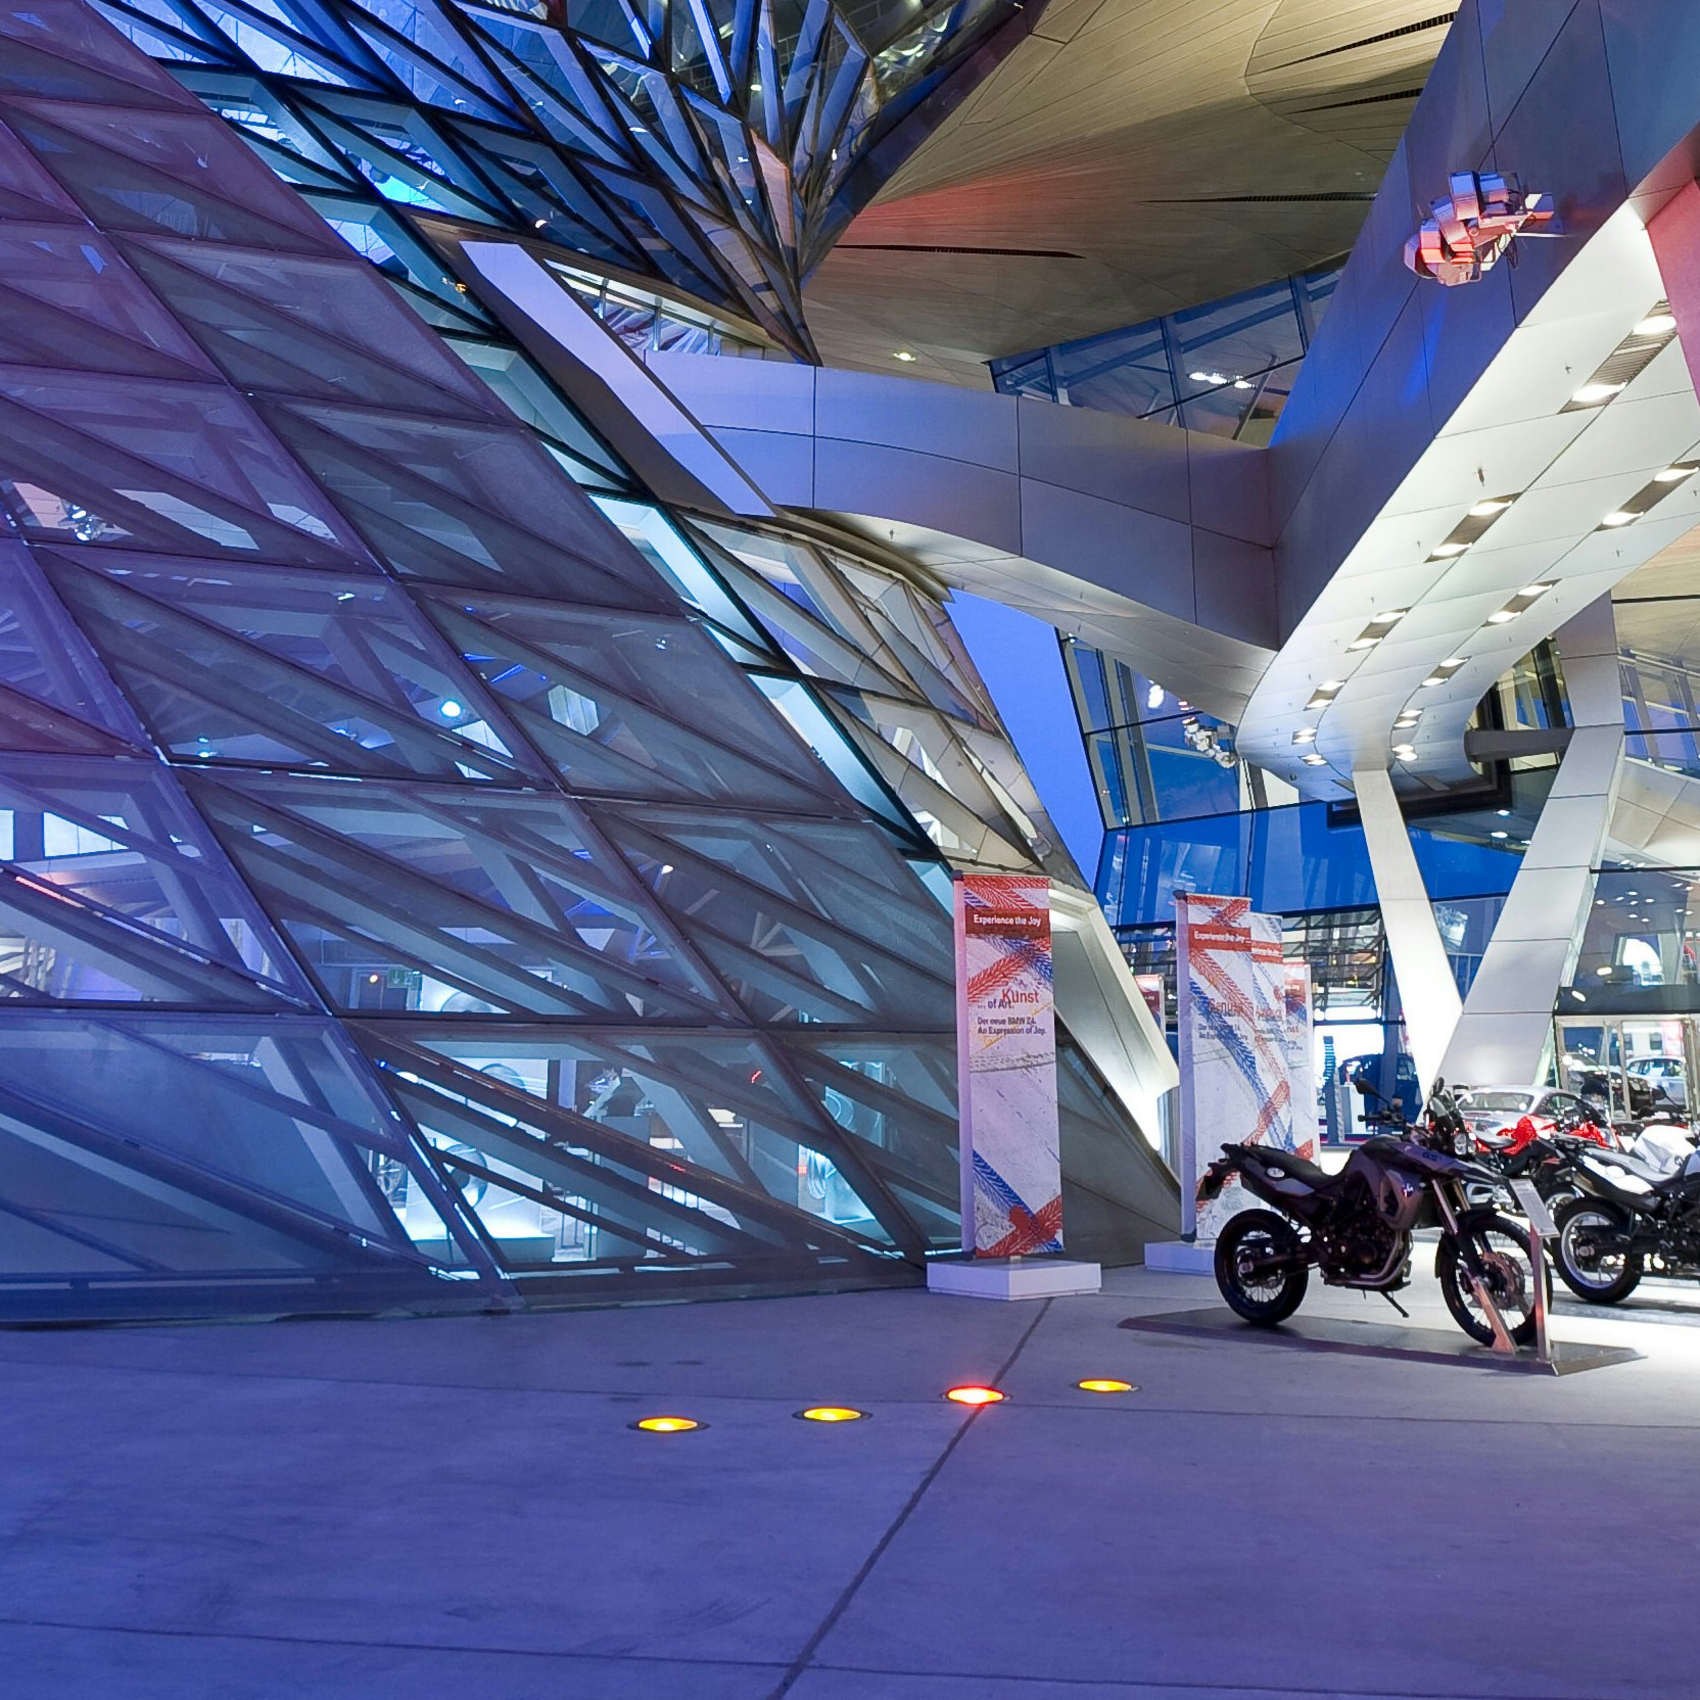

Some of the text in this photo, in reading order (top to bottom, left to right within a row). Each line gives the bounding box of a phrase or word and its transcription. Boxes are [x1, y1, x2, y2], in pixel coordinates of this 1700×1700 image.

[973, 914, 1041, 927] Experience the Joy
[1002, 988, 1039, 1003] Kunst
[988, 999, 996, 1009] of
